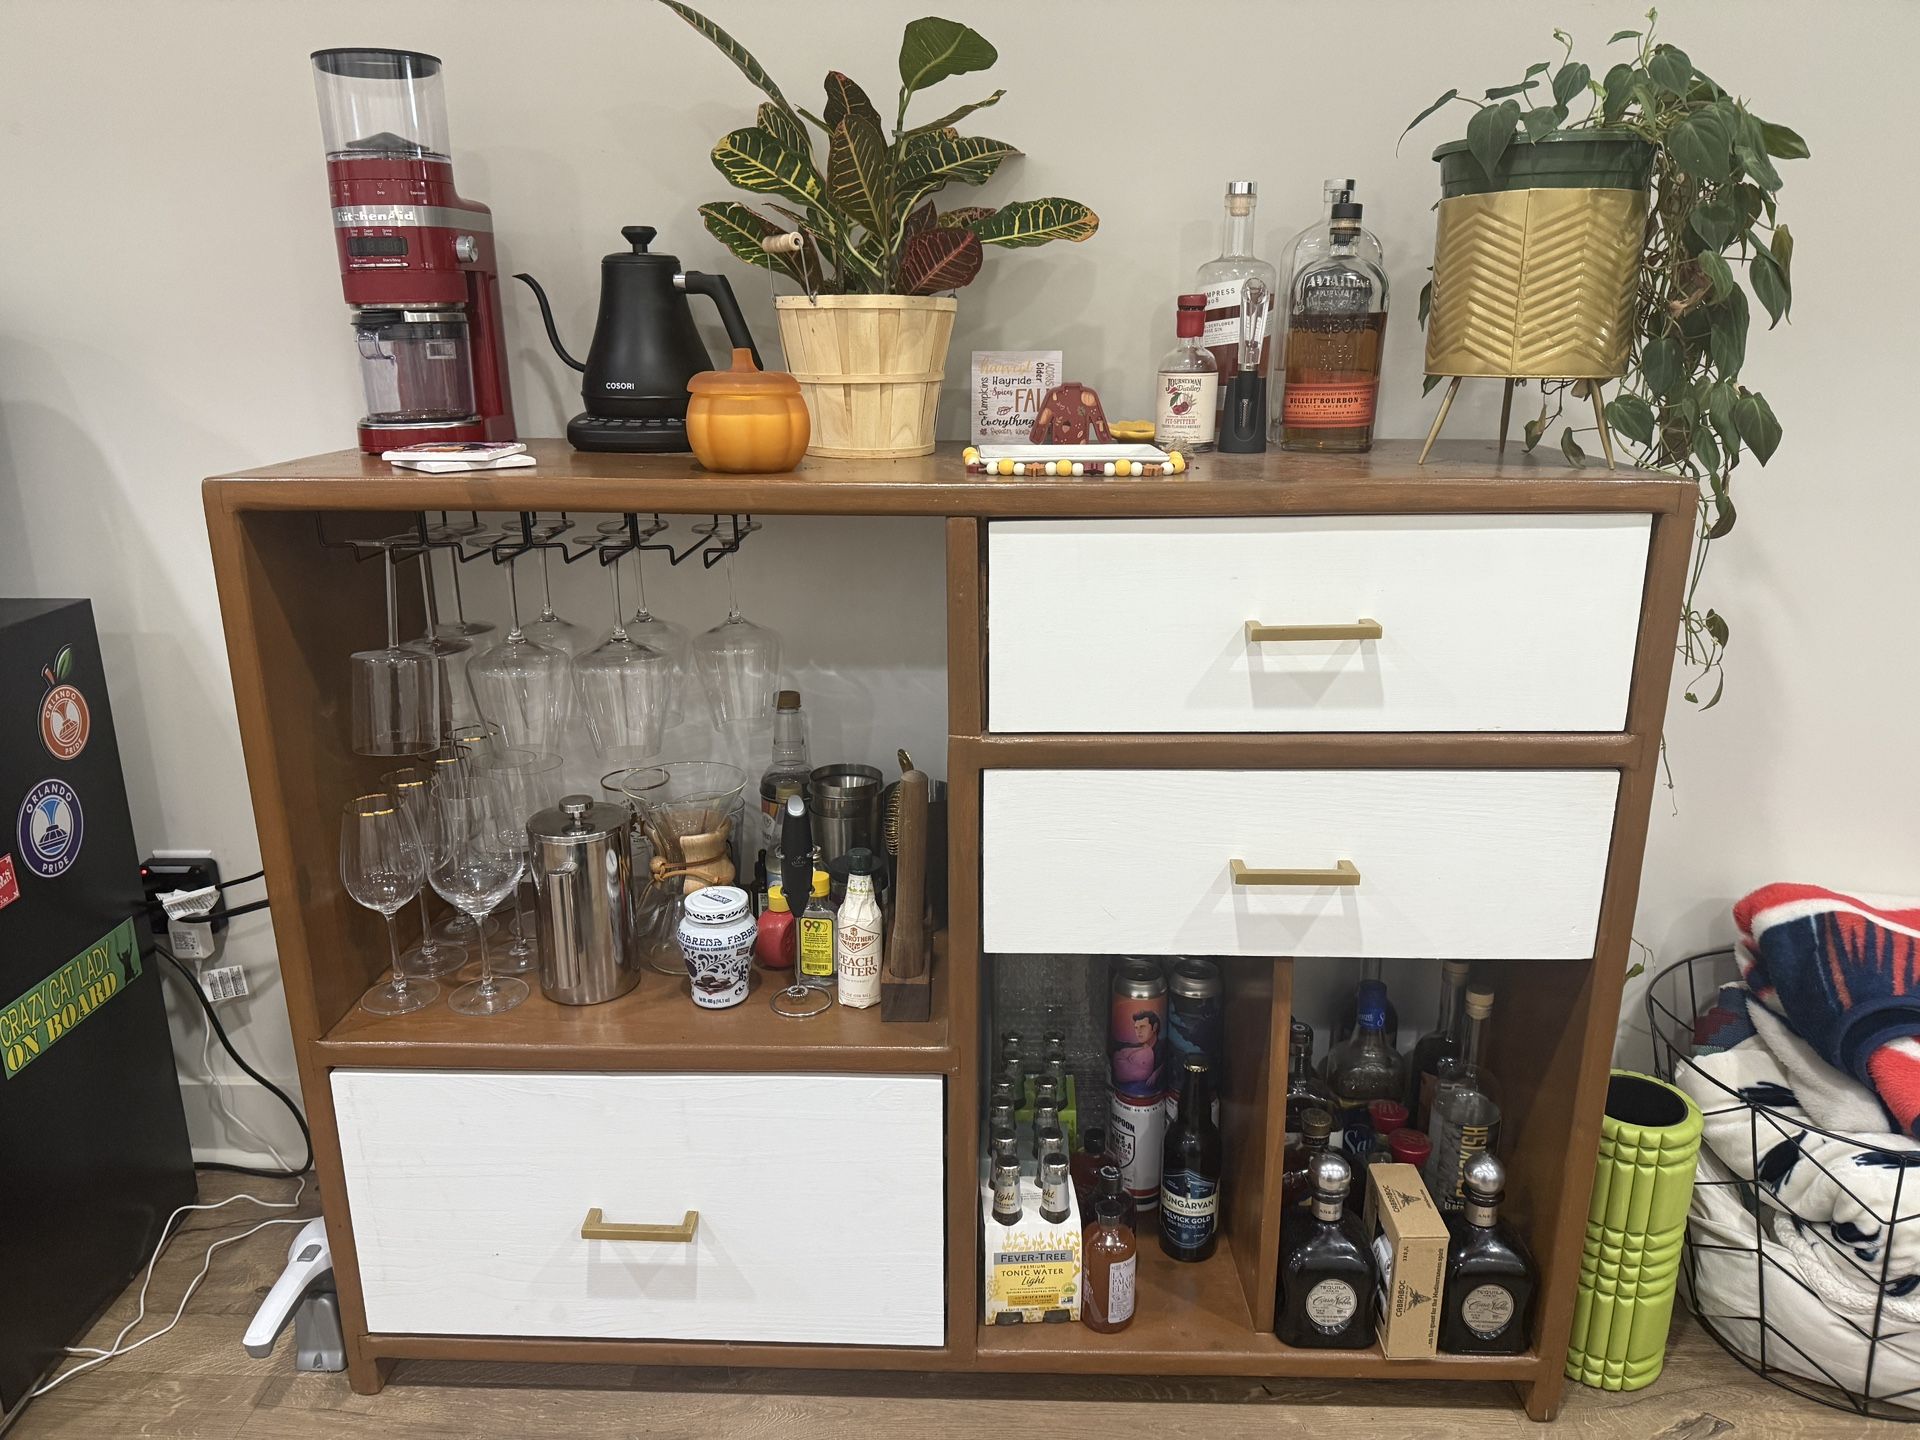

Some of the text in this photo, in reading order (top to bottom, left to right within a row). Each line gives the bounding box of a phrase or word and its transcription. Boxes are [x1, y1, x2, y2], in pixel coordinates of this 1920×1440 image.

[1206, 287, 1236, 298] MPRESS
[1036, 362, 1045, 383] Cider
[605, 382, 635, 390] COSORI
[992, 376, 1032, 387] Hayride
[978, 376, 991, 416] Pumpkins
[991, 386, 1014, 399] Spices
[1015, 388, 1050, 413] FAL
[1319, 396, 1360, 405] BOURBON
[980, 414, 1036, 429] Everything
[45, 690, 77, 720] ORLANDO
[64, 738, 83, 755] PRIDE
[26, 783, 73, 814] ORLANDO
[41, 855, 70, 874] PRIDE
[845, 934, 875, 942] BROTHERS
[839, 963, 878, 976] ITTERS
[0, 940, 110, 1048] CRAZY CAT LADY
[7, 971, 118, 1072] ON BOARD
[1162, 1191, 1214, 1210] DUNGARVAN
[1190, 1215, 1211, 1225] GOLD
[1033, 1268, 1064, 1276] WATER
[1432, 1262, 1443, 1298] Mediterranean
[1021, 1275, 1046, 1287] Light
[1396, 1280, 1406, 1317] CABRABOC
